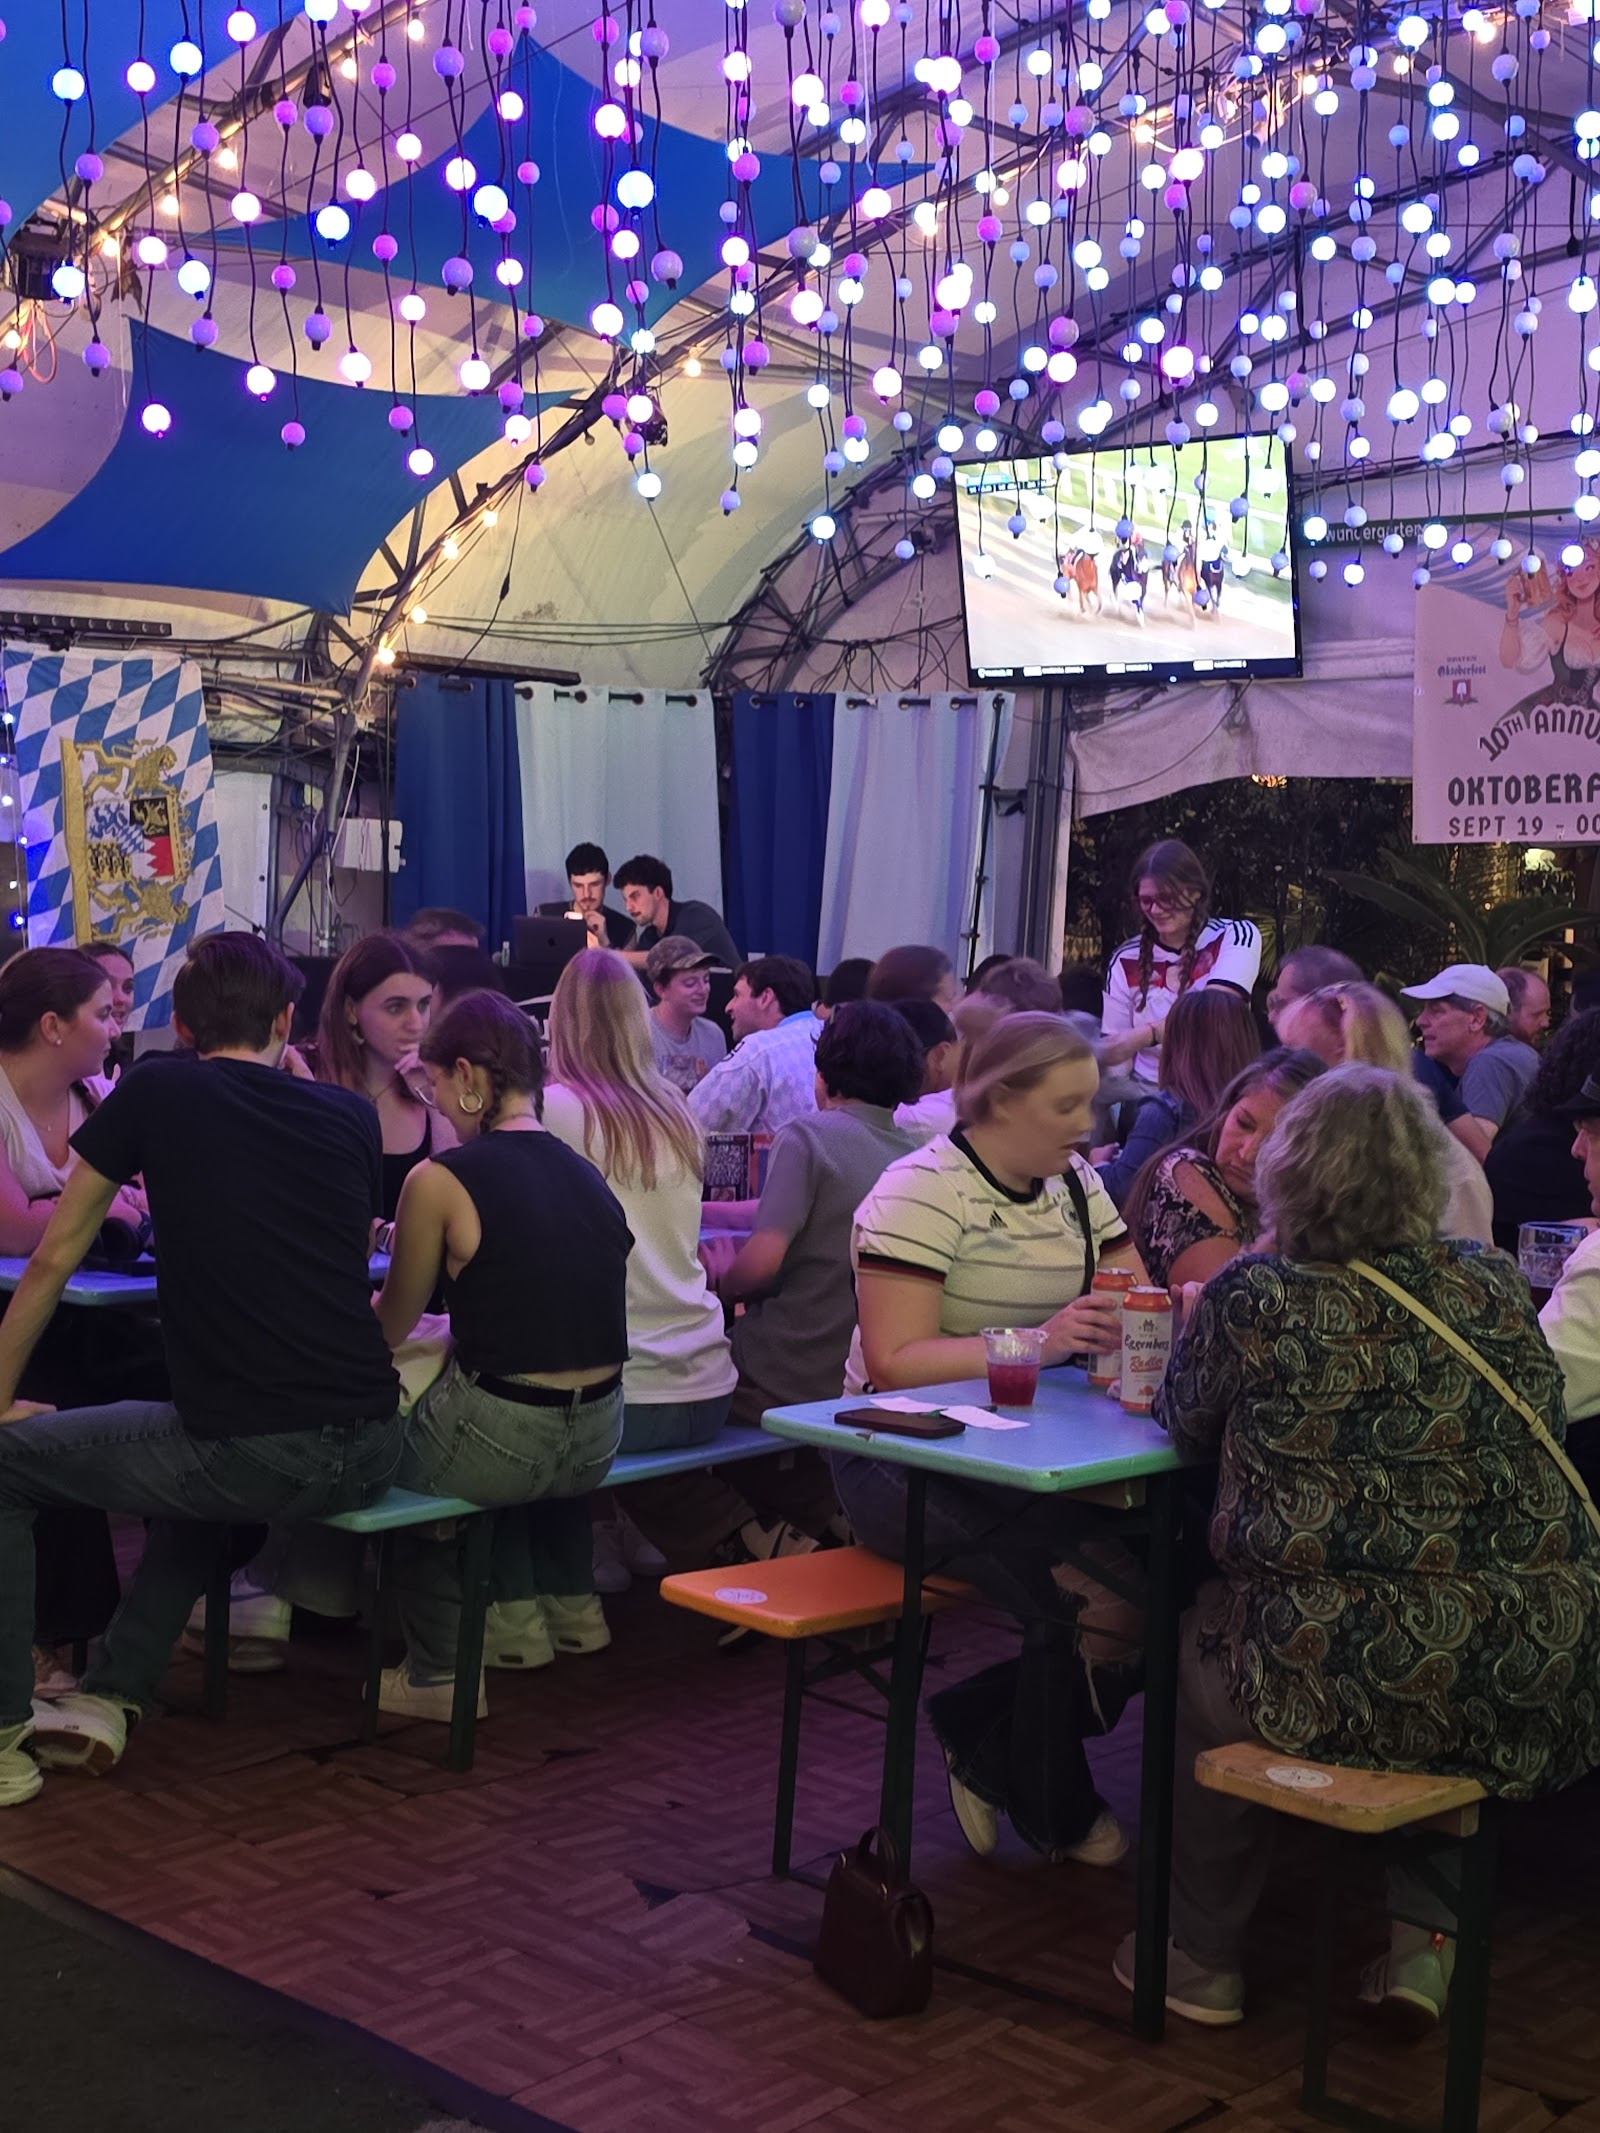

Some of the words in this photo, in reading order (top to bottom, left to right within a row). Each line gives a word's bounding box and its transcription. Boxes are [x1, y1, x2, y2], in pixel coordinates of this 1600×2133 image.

[1534, 708, 1600, 746] ANNU
[1449, 815, 1505, 837] SEPT
[1517, 816, 1543, 836] 19
